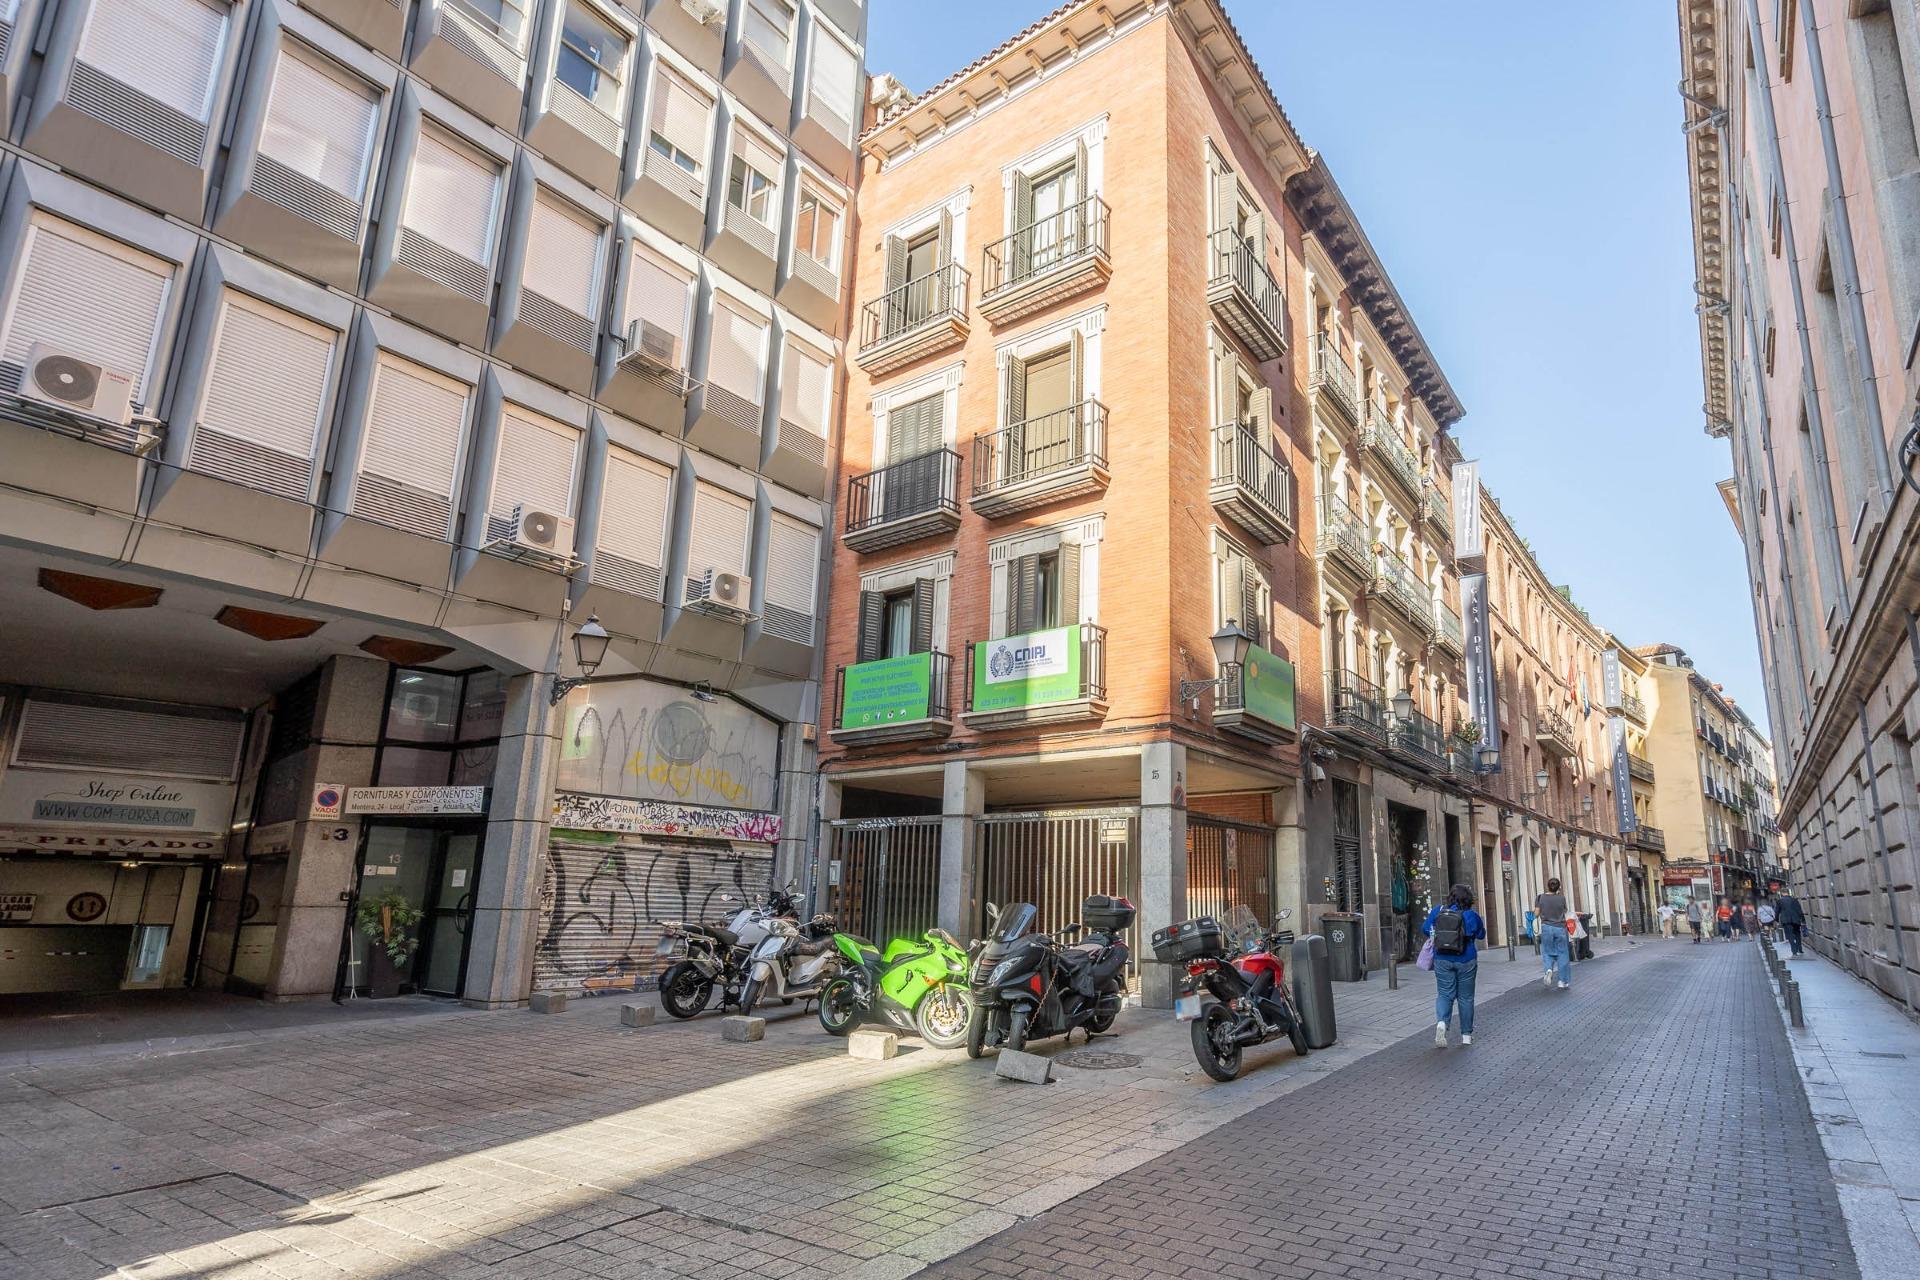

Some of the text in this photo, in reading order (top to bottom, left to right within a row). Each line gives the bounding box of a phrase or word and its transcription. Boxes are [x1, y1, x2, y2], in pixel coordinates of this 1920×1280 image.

[1470, 587, 1489, 746] CASA DE LA LÍRIC
[80, 781, 183, 801] Shop Online
[353, 788, 475, 800] FORNITURAS Y COMPONENTES
[314, 806, 339, 814] VADO
[389, 803, 405, 811] Local
[37, 836, 215, 849] PRIVADO
